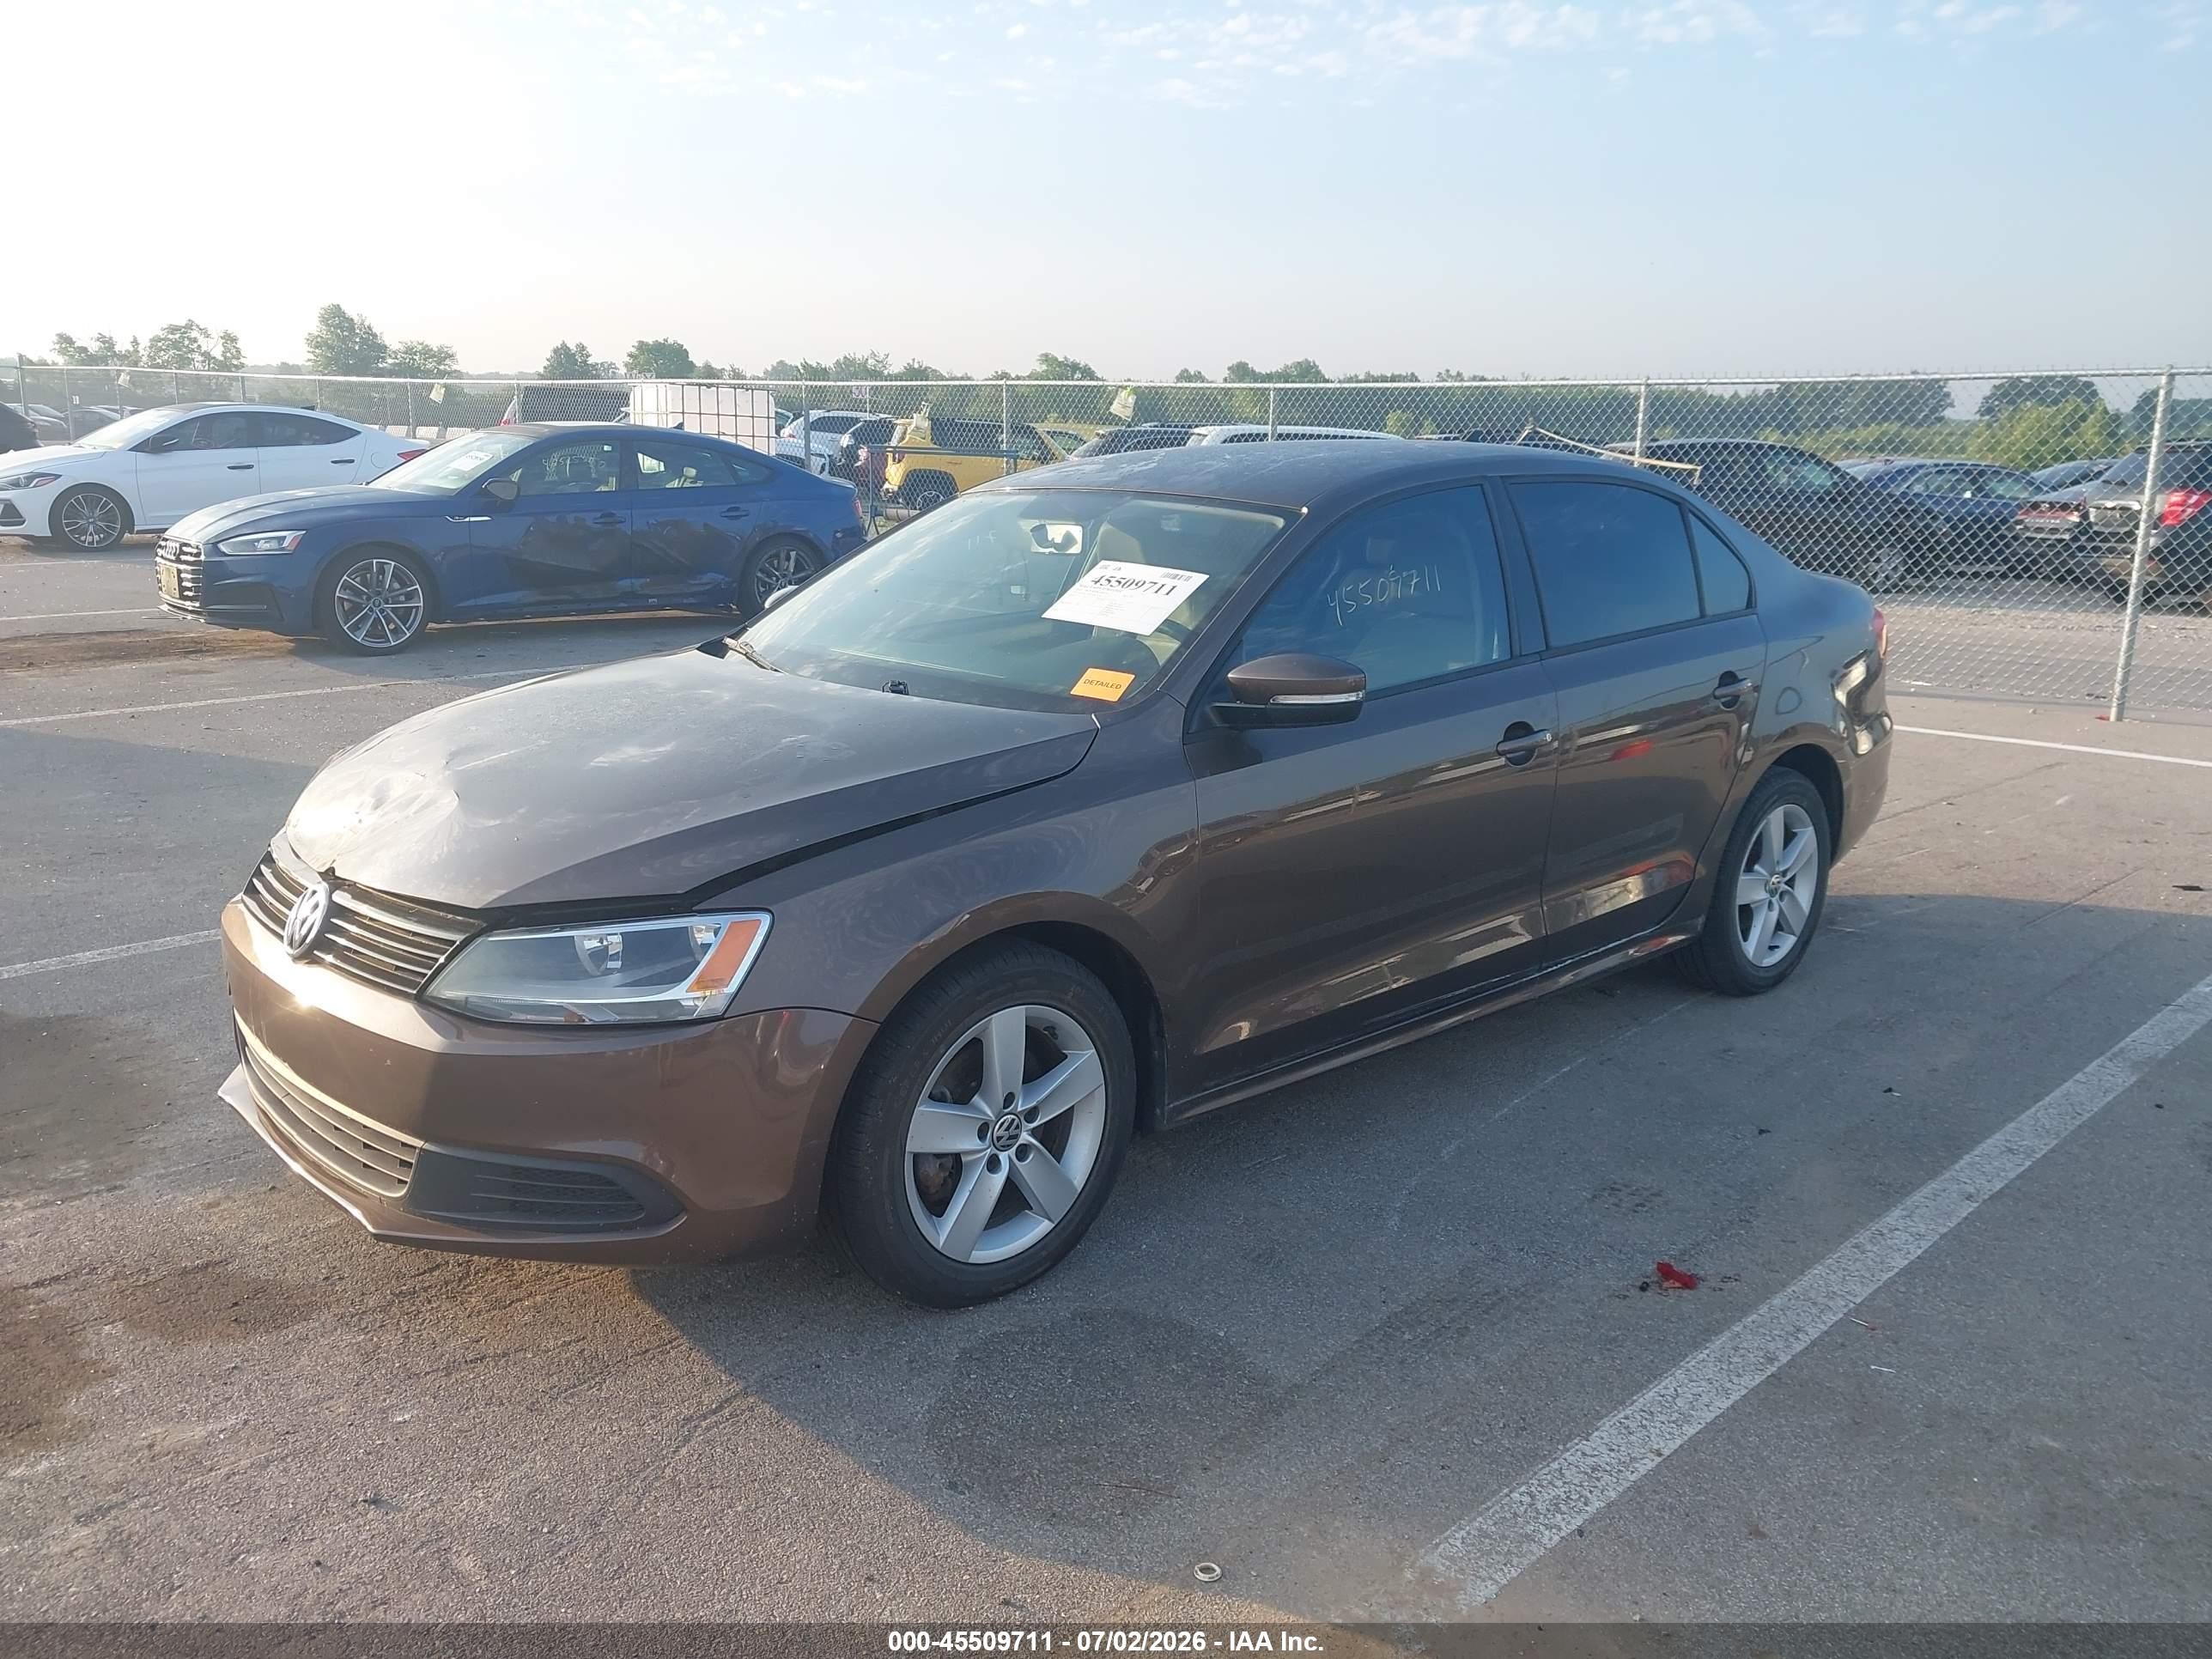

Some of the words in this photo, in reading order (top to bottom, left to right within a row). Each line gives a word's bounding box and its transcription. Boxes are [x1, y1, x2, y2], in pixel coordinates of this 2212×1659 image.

[1091, 574, 1178, 596] 45509711
[1326, 563, 1442, 626] 45509711
[1084, 678, 1122, 690] DETAILED
